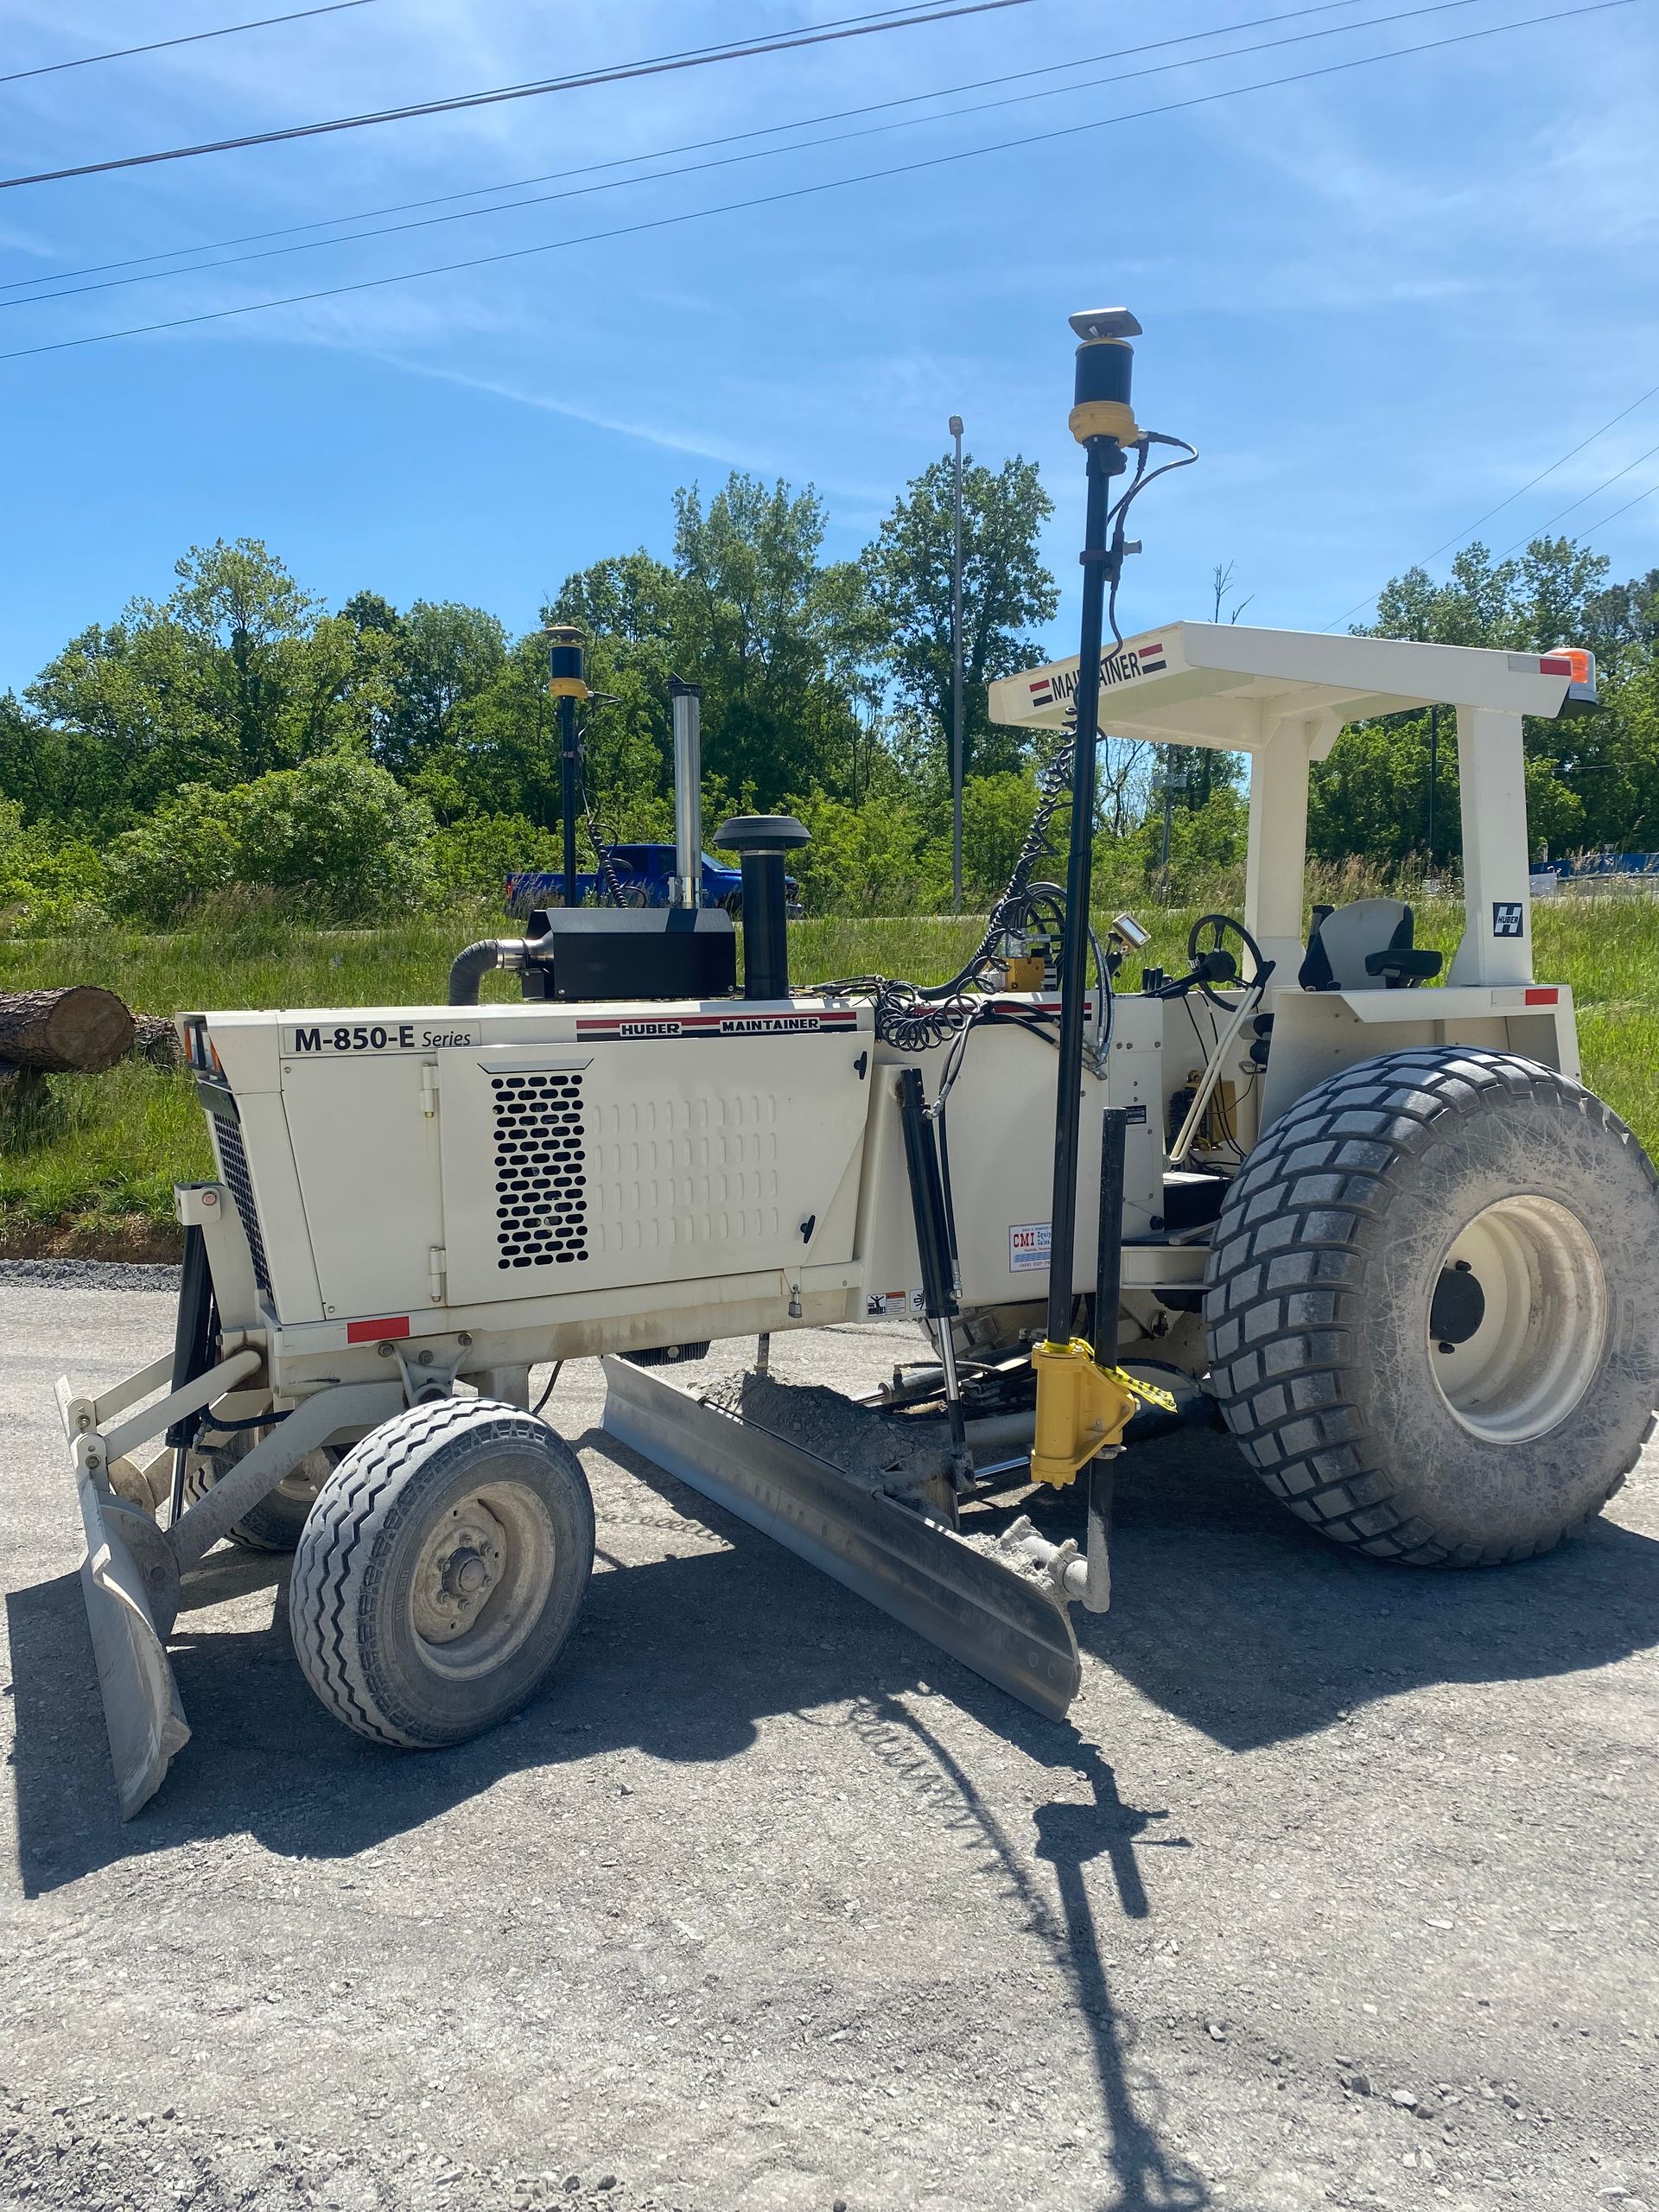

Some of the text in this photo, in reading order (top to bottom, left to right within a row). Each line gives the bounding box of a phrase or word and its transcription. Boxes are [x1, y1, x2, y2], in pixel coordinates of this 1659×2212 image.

[1052, 652, 1141, 701] MAIAINER
[621, 1018, 819, 1035] HUBER MAINTAINER
[295, 1025, 471, 1052] M-850-E Series
[1014, 1232, 1034, 1248] CMI
